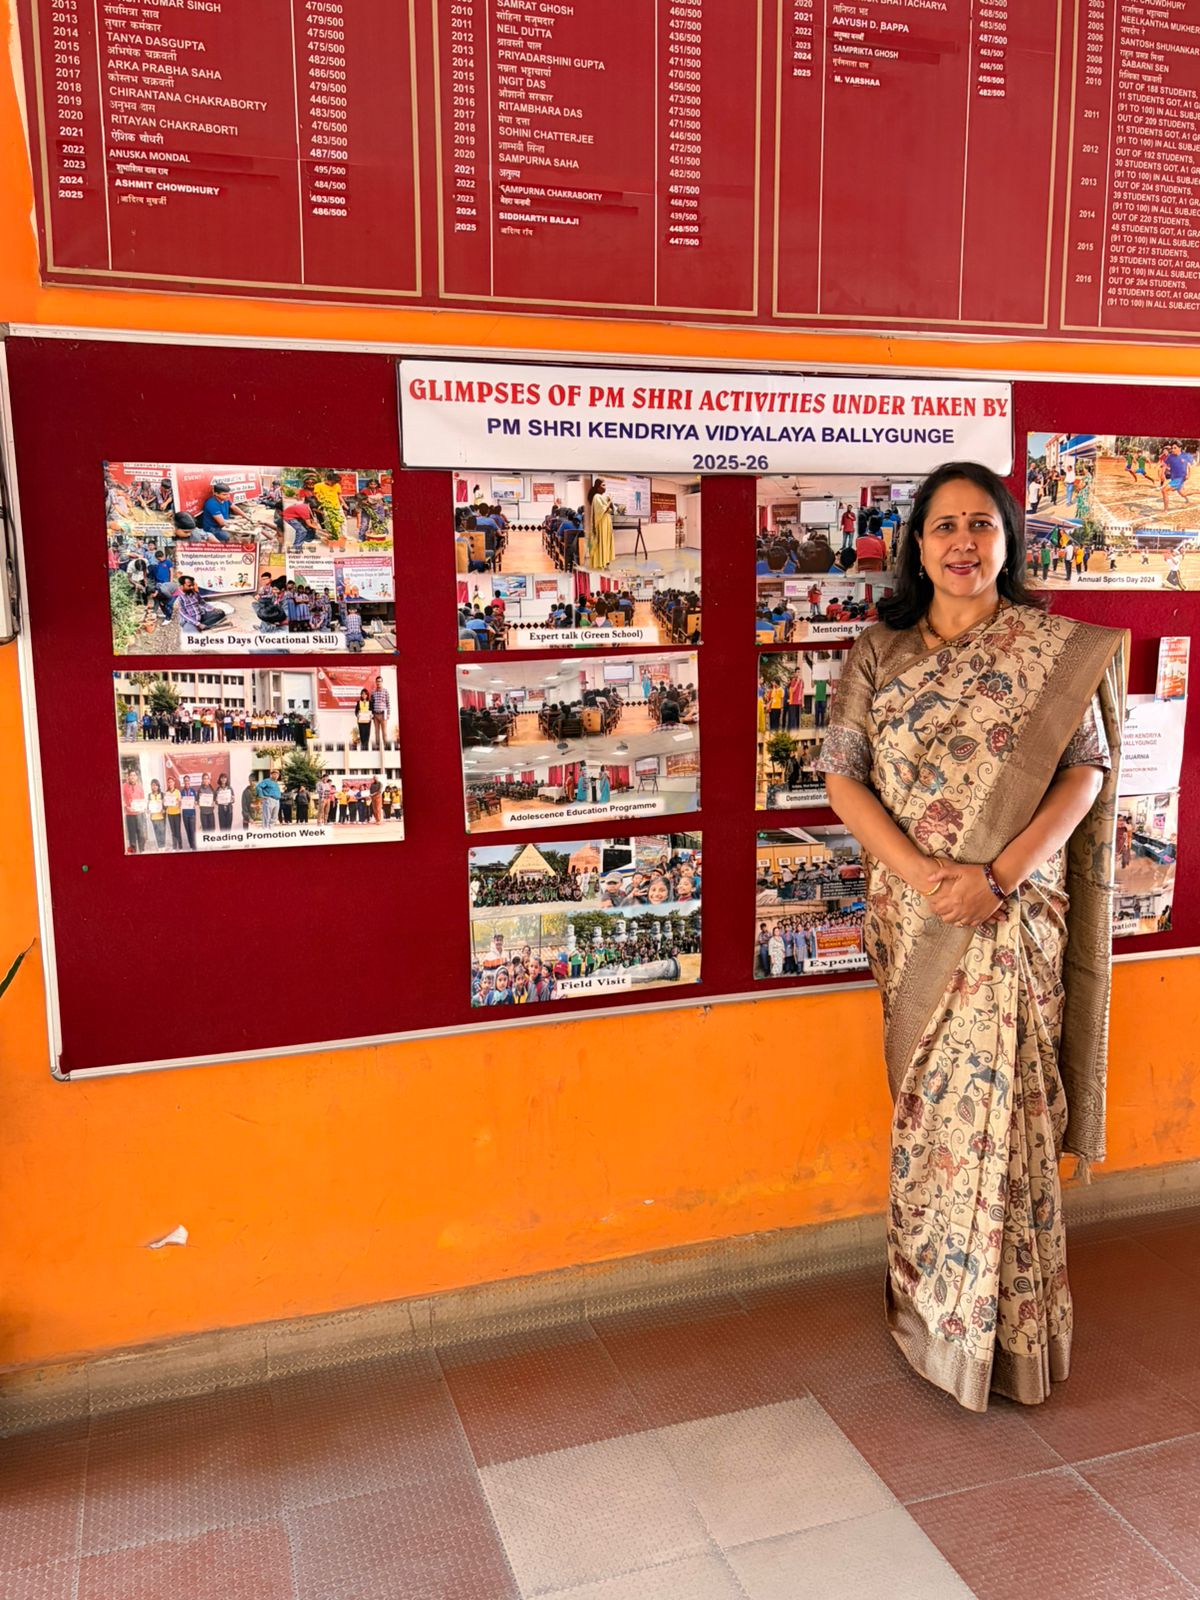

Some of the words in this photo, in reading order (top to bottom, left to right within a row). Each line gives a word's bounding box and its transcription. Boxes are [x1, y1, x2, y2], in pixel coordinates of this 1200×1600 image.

[187, 0, 221, 12] SINGH
[305, 1, 343, 13] 470/500
[451, 5, 473, 16] 2010
[540, 3, 574, 16] GHOSH
[670, 7, 702, 18] 460/500
[794, 12, 813, 21] 2021
[979, 9, 1007, 20] 468/500
[1088, 10, 1104, 19] 2004
[52, 13, 78, 24] 2013
[307, 15, 344, 27] 479/500
[451, 18, 472, 29] 2011
[669, 20, 701, 30] 437/500
[833, 17, 868, 29] AAYUSH
[870, 20, 878, 29] D.
[881, 22, 909, 33] BAPPA
[53, 27, 78, 38] 2014
[307, 28, 344, 40] 475/500
[497, 24, 519, 35] NEIL
[521, 26, 552, 38] DUTTA
[107, 32, 142, 44] TANYA
[145, 36, 205, 51] DASGUPTA
[452, 32, 473, 42] 2012
[979, 34, 1007, 44] 487/500
[1087, 44, 1103, 52] 2007
[1120, 38, 1154, 49] SANTOSH
[669, 45, 701, 55] 451/500
[834, 44, 873, 57] SAMPRIKTA
[875, 48, 899, 59] GHOSH
[55, 54, 80, 65] 2016
[309, 55, 345, 67] 482/500
[499, 50, 571, 66] PRIYADARSHINI
[574, 58, 605, 70] GUPTA
[794, 52, 811, 60] 2024
[452, 58, 474, 68] 2014
[669, 57, 701, 68] 471/500
[1122, 60, 1153, 70] SABARNI
[1155, 63, 1169, 72] SEN
[56, 68, 80, 79] 2017
[108, 60, 139, 71] ARKA
[142, 63, 188, 76] PRABHA
[191, 68, 222, 80] SAHA
[309, 68, 346, 80] 486/500
[793, 69, 811, 77] 2025
[499, 76, 524, 86] INGIT
[526, 79, 546, 89] DAS
[834, 75, 842, 83] M.
[1086, 77, 1102, 86] 2010
[669, 83, 700, 93] 456/500
[1119, 81, 1134, 89] OUT
[1136, 83, 1145, 91] OF
[57, 95, 82, 106] 2019
[110, 87, 181, 103] CHIRANTANA
[184, 94, 267, 111] CHAKRABORTY
[58, 109, 83, 120] 2020
[310, 108, 347, 119] 483/500
[499, 102, 561, 116] RITAMBHARA
[564, 108, 583, 118] DAS
[1084, 110, 1099, 118] 2011
[111, 114, 156, 128] RITAYAN
[160, 119, 238, 136] CHAKRABORTI
[454, 122, 475, 132] 2018
[60, 127, 83, 137] 2021
[499, 127, 531, 138] SOHINI
[534, 130, 594, 144] CHATTERJEE
[63, 145, 85, 154] 2022
[310, 148, 348, 160] 487/500
[109, 149, 147, 159] ANUSKA
[149, 152, 190, 163] MONDAL
[499, 154, 551, 166] SAMPURNA
[554, 158, 579, 168] SAHA
[314, 166, 346, 175] 495/500
[455, 165, 475, 175] 2021
[59, 176, 83, 184] 2024
[1081, 177, 1097, 186] 2013
[115, 179, 153, 189] ASHMIT
[156, 182, 219, 195] CHOWDHURY
[669, 185, 699, 194] 487/500
[59, 190, 83, 199] 2025
[312, 208, 347, 217] 486/500
[456, 207, 476, 216] 2024
[499, 212, 547, 223] SIDDHARTH
[550, 216, 579, 226] BALAJI
[1109, 277, 1122, 285] OUT
[1117, 288, 1154, 298] STUDENTS
[409, 379, 540, 405] GLIMPSES
[548, 384, 581, 406] OF
[589, 386, 624, 408] PM
[632, 387, 693, 410] SHRI
[700, 390, 826, 413] ACTIVITIES
[833, 394, 905, 415] UNDER
[912, 396, 976, 417] TAKEN
[983, 398, 1008, 417] BY
[487, 418, 520, 435] PM
[528, 420, 581, 437] SHRI
[588, 422, 700, 442] KENDRIYA
[705, 425, 816, 442] VIDYALAYA
[822, 427, 954, 443] BALLYGUNGE
[693, 454, 768, 470] 2025-26
[813, 624, 852, 633] Mentoring
[187, 635, 224, 644] Bagless
[227, 635, 251, 644] Days
[254, 635, 309, 644] (Vocational
[312, 635, 339, 645] Skill)
[530, 632, 559, 641] Expert
[561, 631, 578, 639] talk
[580, 631, 610, 640] (Green
[612, 630, 643, 639] School)
[510, 811, 564, 822] Adolescence
[567, 806, 607, 816] Education
[610, 801, 657, 812] Programme
[203, 834, 243, 843] Reading
[246, 830, 297, 840] Promotion
[810, 957, 866, 967] Exposur
[561, 980, 592, 990] Field
[598, 978, 626, 986] Visit
